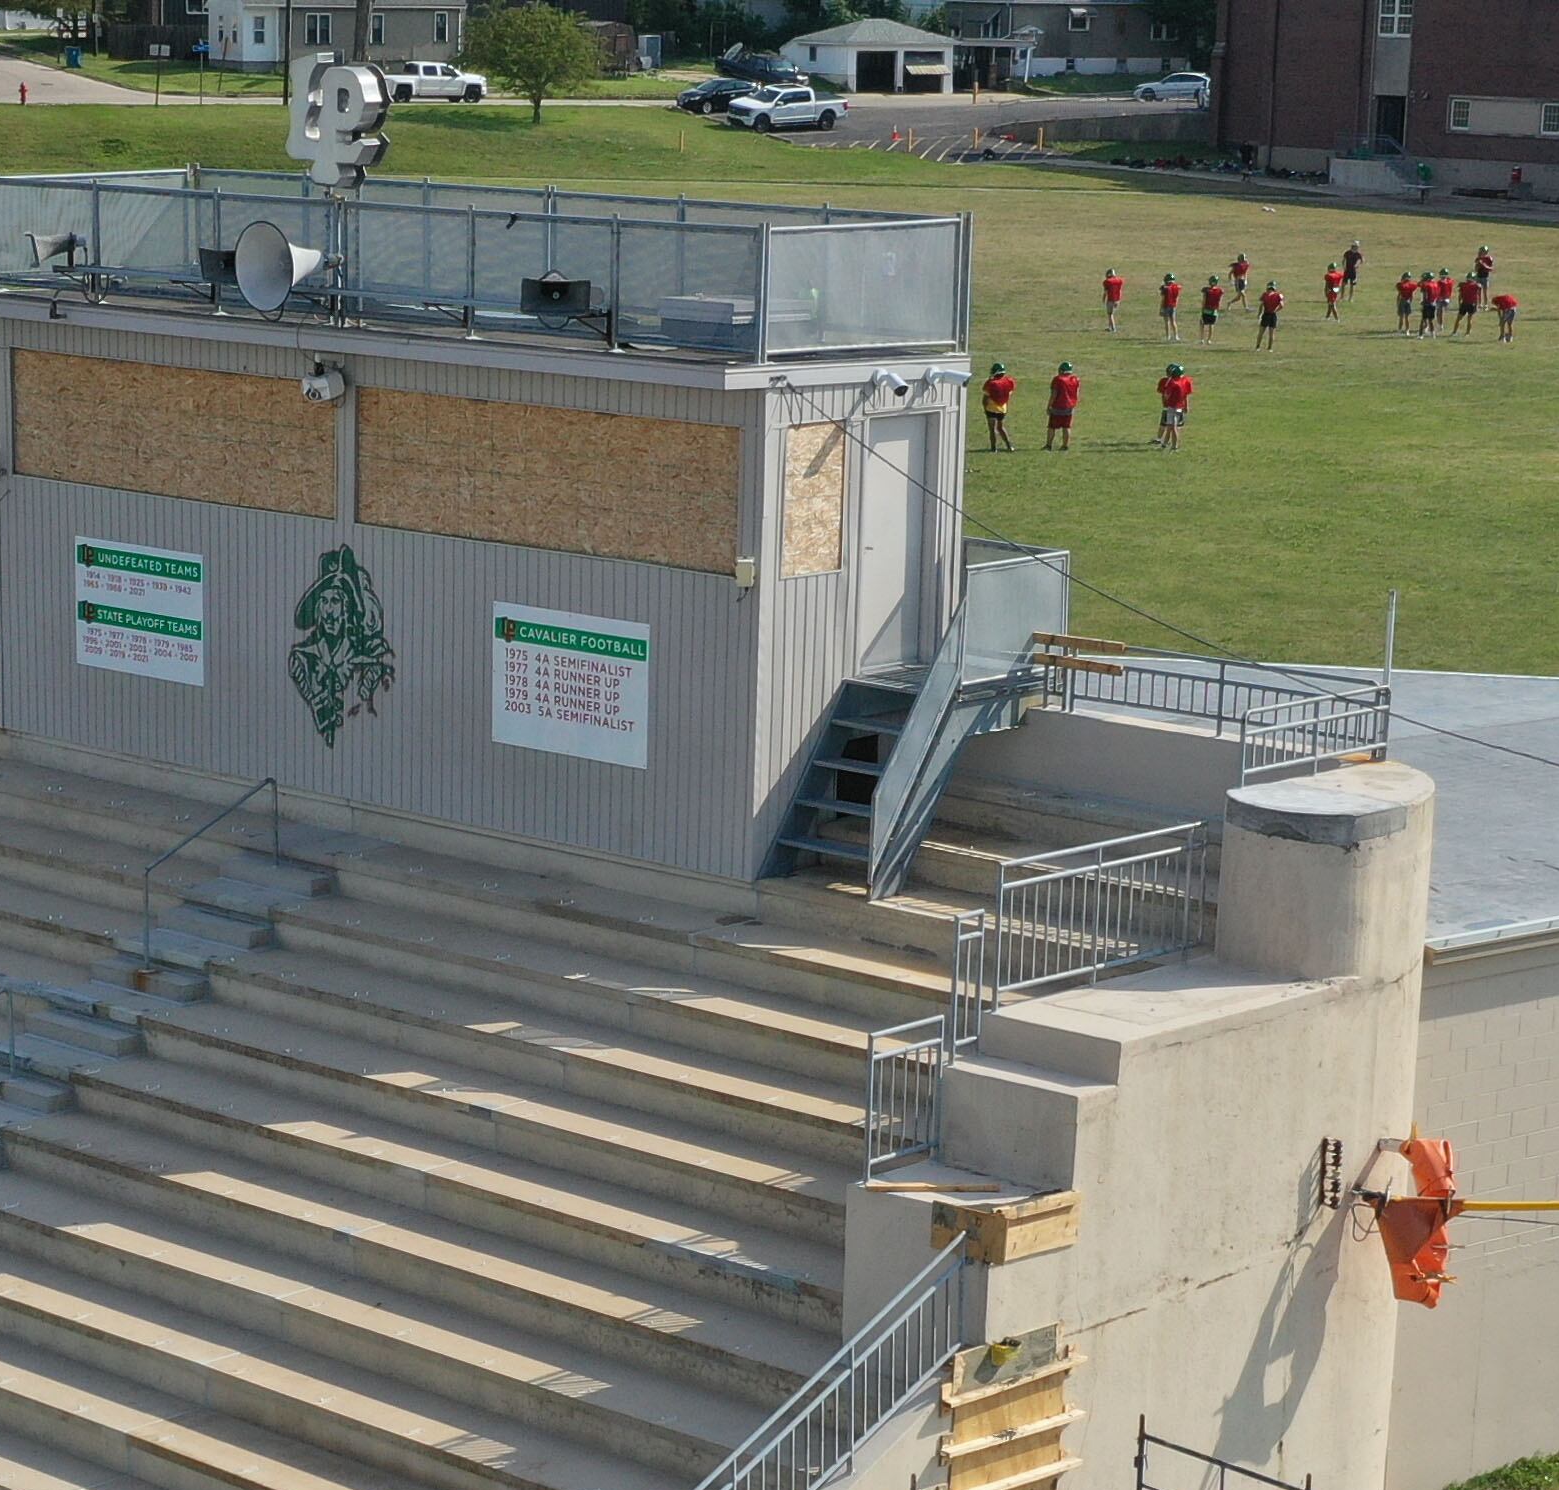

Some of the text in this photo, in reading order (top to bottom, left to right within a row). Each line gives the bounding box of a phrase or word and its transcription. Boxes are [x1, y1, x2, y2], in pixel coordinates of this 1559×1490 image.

[97, 552, 198, 578] UNDEFEATED TEAMS
[97, 610, 198, 635] STATE PLAYOFF TEAMS
[519, 626, 645, 656] CAVALIER FOOTBALL
[504, 647, 632, 678] 1975 4A SEMIFINALIST
[504, 661, 620, 688] 1977 4A RUNNER UP
[504, 674, 620, 702] 1978 4A RUNNER UP
[504, 687, 620, 716] 1979 4A RUNNER UP
[504, 700, 635, 732] 2003 5A SEMIFINALIST
